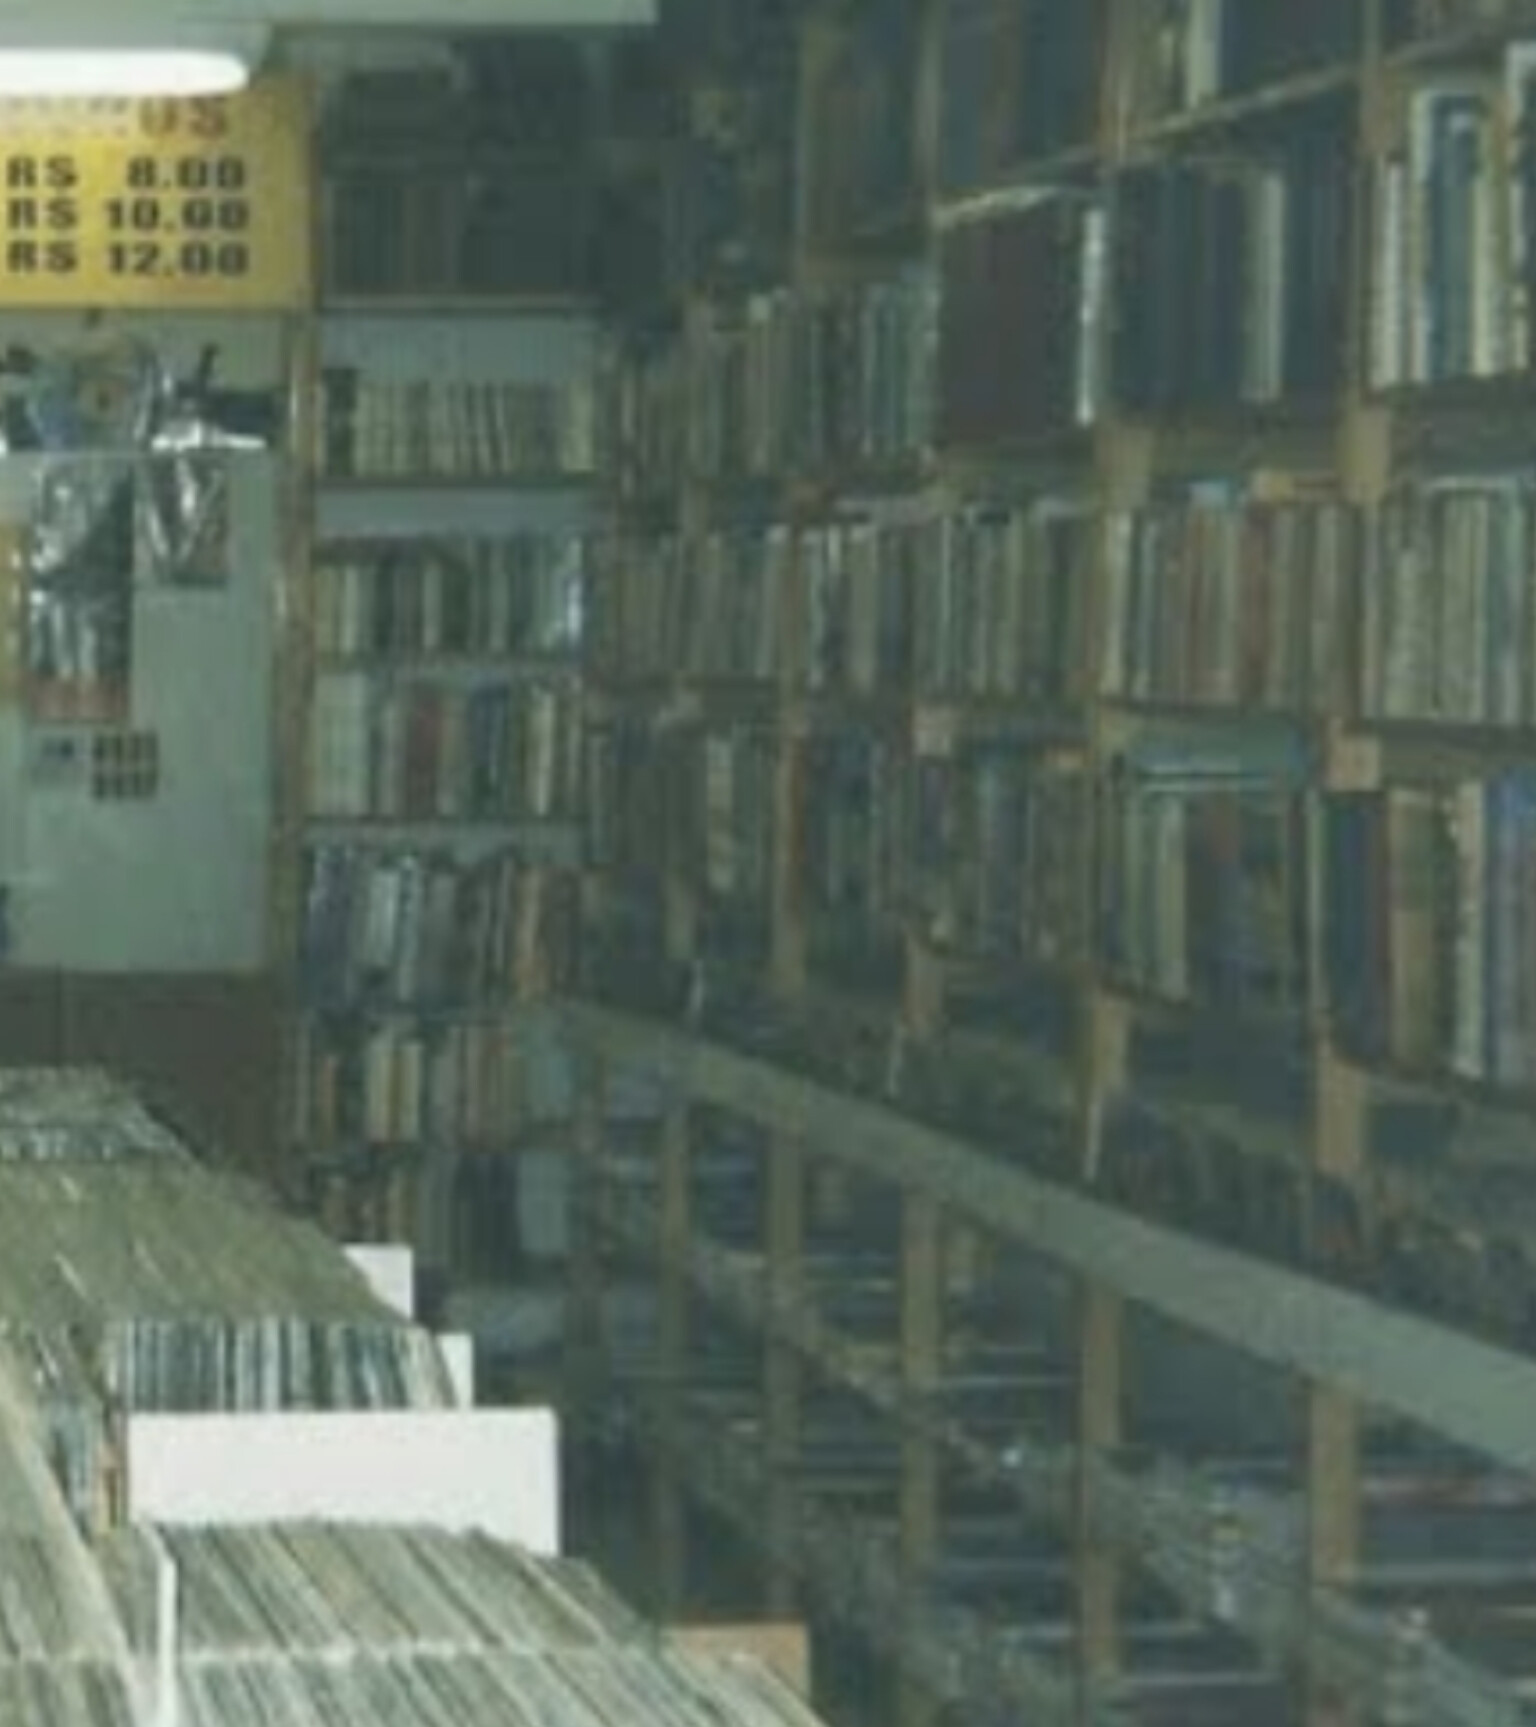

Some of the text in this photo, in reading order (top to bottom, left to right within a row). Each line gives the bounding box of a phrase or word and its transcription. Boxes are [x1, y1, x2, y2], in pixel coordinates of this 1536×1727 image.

[127, 155, 246, 190] 8.00
[107, 196, 250, 232] 10.00
[107, 239, 250, 277] 12.00
